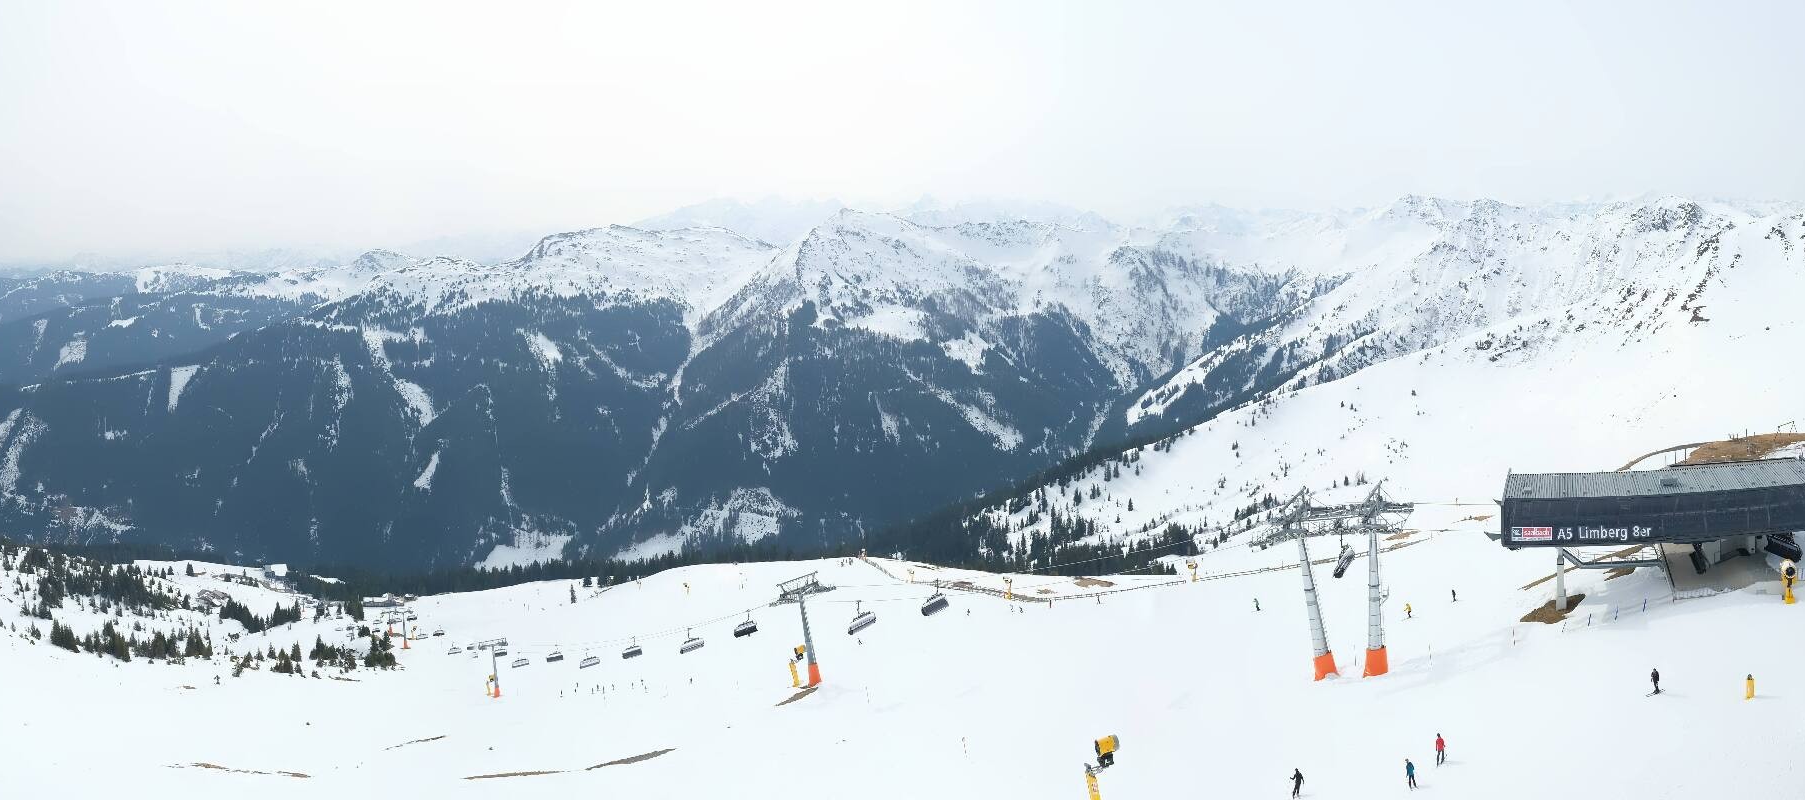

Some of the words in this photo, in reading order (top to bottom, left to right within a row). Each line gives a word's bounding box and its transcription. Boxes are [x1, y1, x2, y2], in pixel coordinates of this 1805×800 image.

[1557, 527, 1573, 540] A5
[1578, 525, 1628, 541] Limberg
[1632, 525, 1652, 538] 8er
